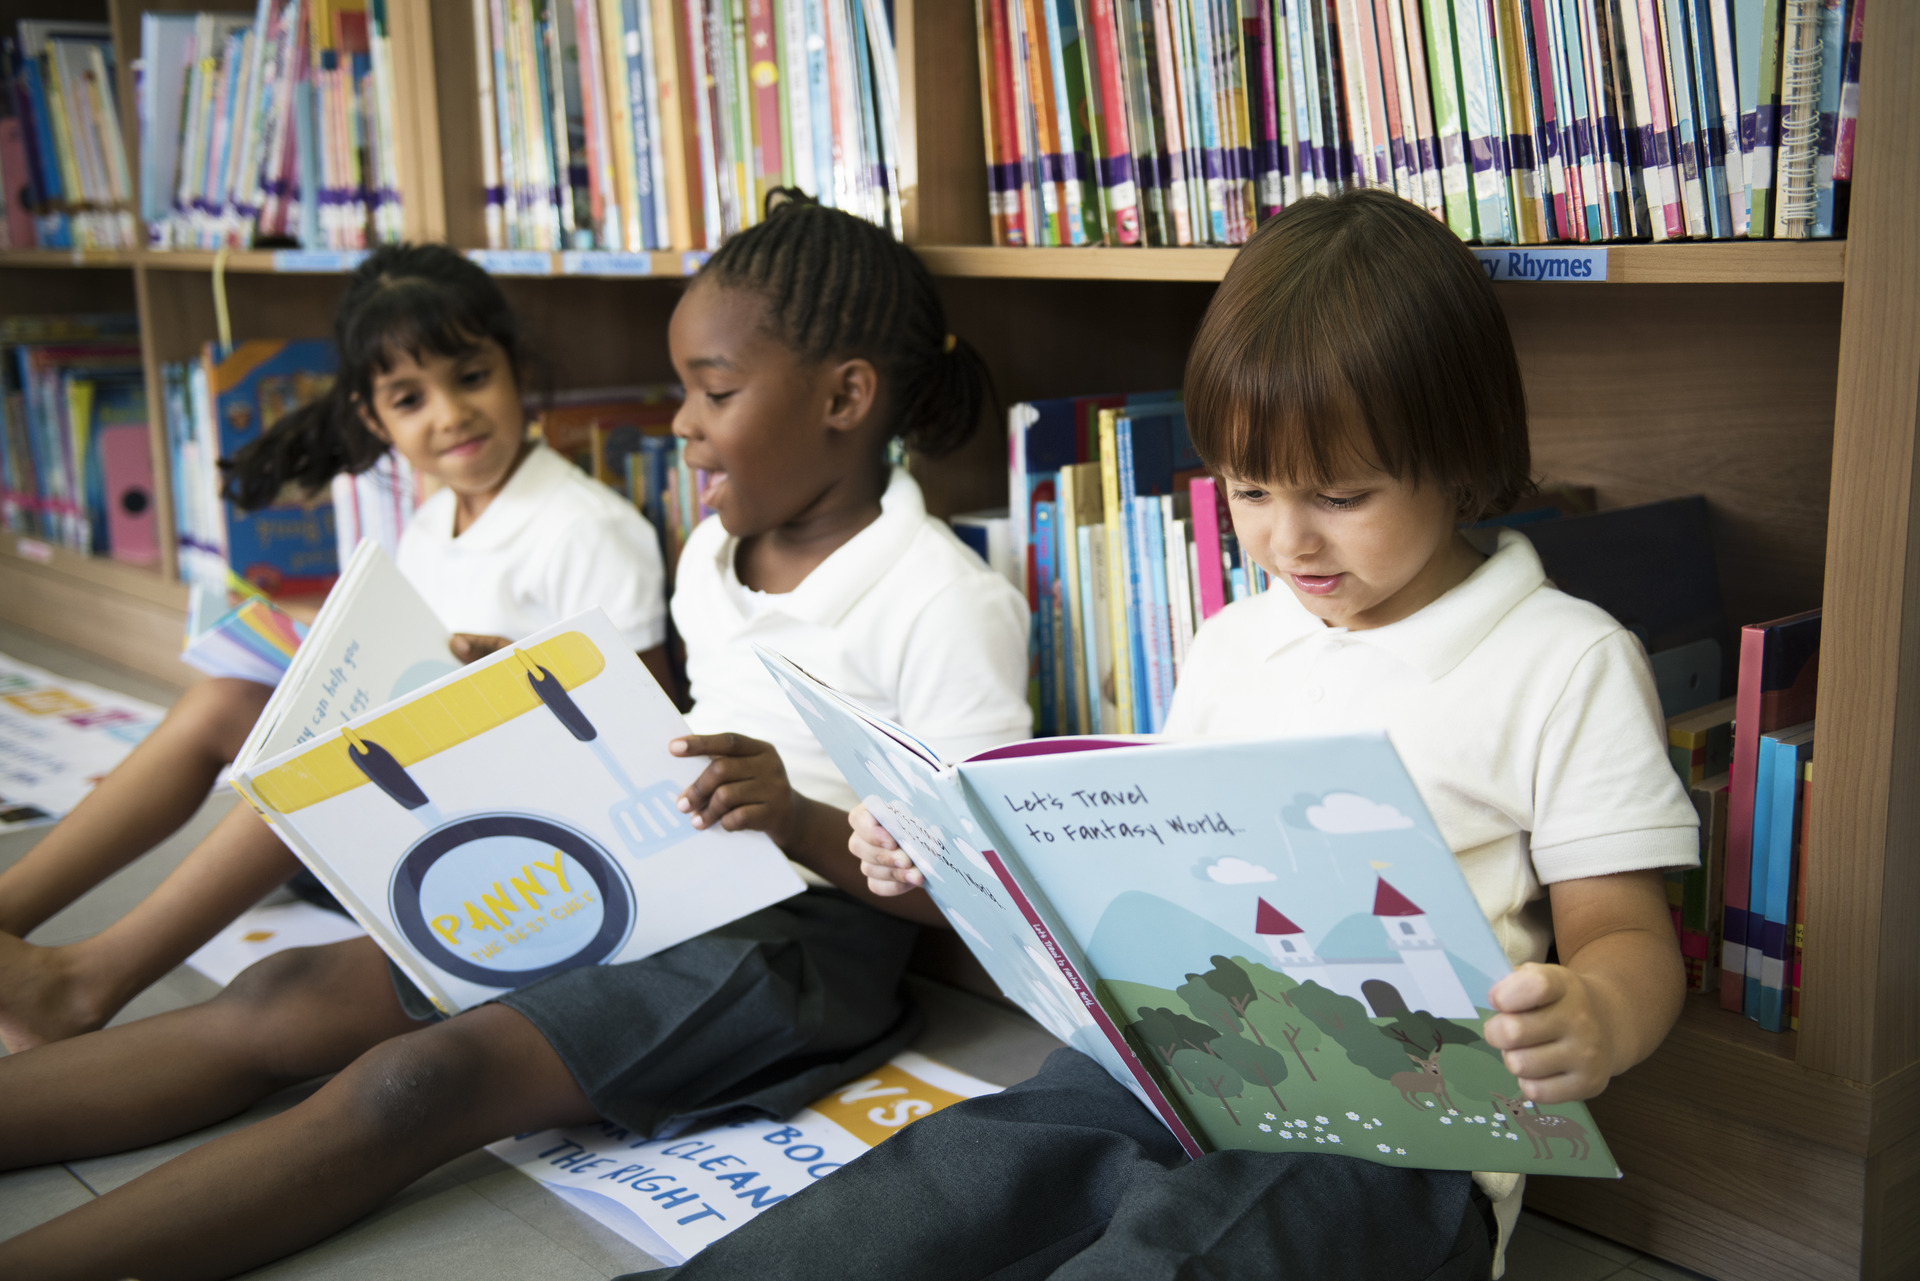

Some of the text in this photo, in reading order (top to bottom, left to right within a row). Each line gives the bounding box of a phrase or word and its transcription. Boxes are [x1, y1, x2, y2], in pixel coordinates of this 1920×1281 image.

[1508, 252, 1592, 281] Rhymes
[312, 698, 329, 725] can
[322, 666, 347, 698] help
[343, 639, 360, 671] you
[1003, 784, 1149, 812] Let's Travel
[1025, 823, 1055, 843] to
[1062, 818, 1165, 846] Fantasy
[430, 849, 571, 946] PANNY
[470, 889, 594, 963] THE BEST CHEF
[1062, 967, 1082, 990] Fantasy
[538, 1137, 727, 1226] THE RIGHT
[660, 1140, 790, 1209] CLEAN
